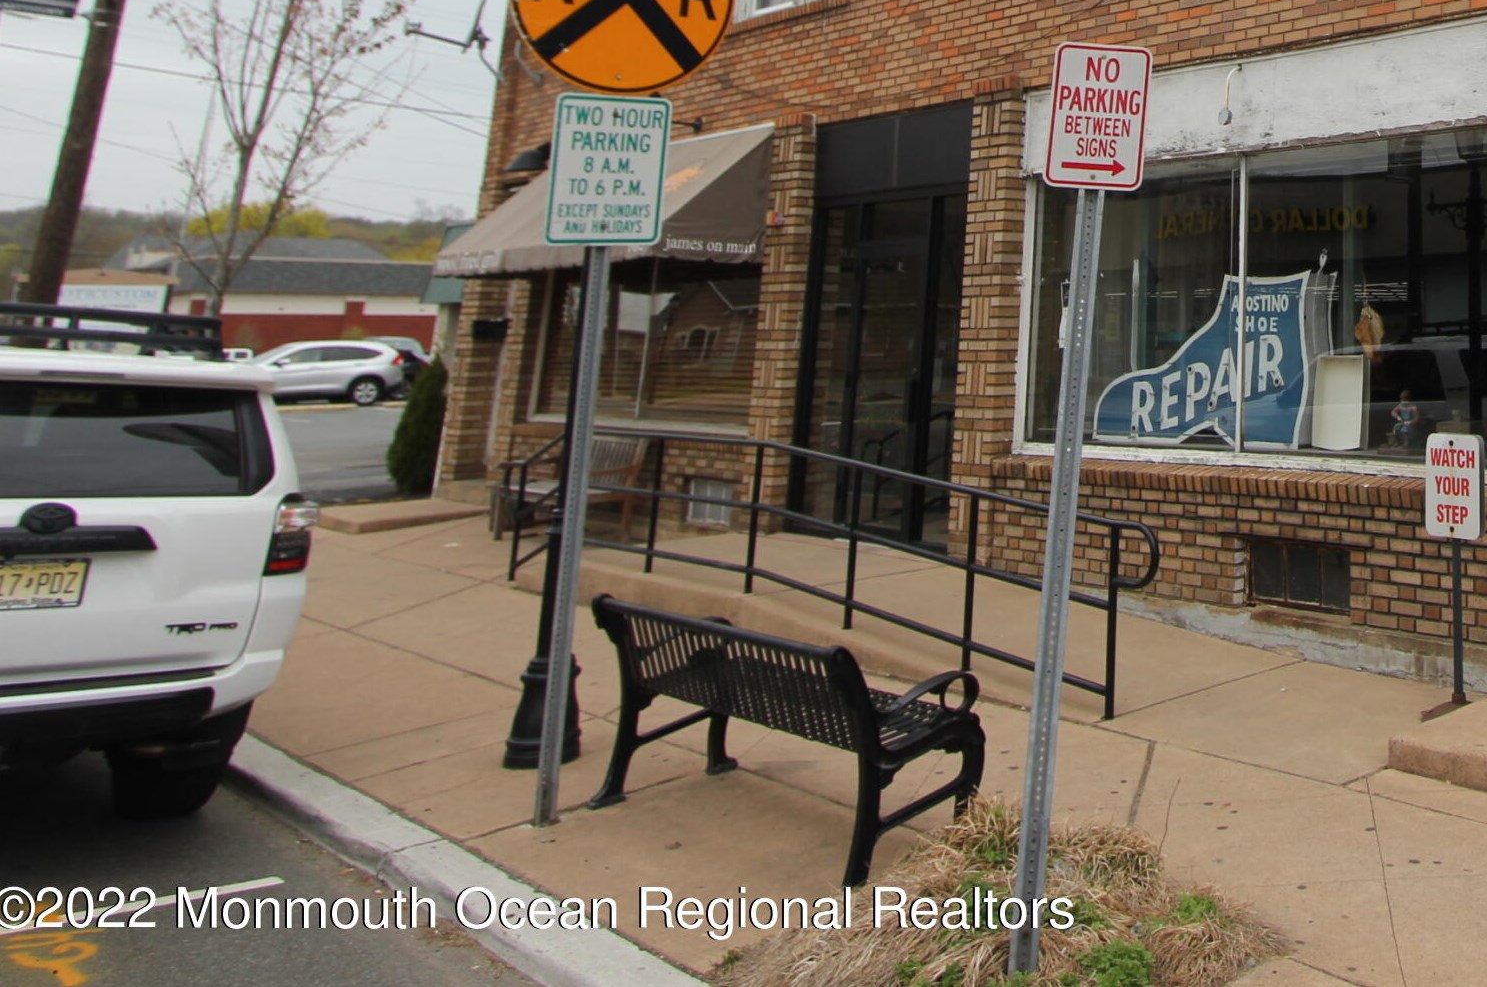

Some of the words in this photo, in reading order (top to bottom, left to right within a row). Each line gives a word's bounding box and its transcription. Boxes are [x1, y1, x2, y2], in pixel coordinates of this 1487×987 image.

[1085, 56, 1120, 83] NO
[1059, 85, 1141, 115] PARKING
[564, 105, 603, 126] TWO
[612, 107, 665, 129] HOUR
[1064, 115, 1131, 137] BETWEEN
[571, 131, 651, 153] PARKING
[1075, 137, 1117, 158] SIGNS
[583, 156, 594, 173] 8
[601, 158, 635, 174] A.M.
[568, 178, 588, 195] TO
[595, 180, 605, 196] 6
[612, 180, 646, 196] P.M.
[557, 203, 598, 218] EXCEPT
[603, 204, 651, 218] SUNDAYS
[663, 234, 703, 251] james
[707, 241, 722, 252] on
[726, 242, 757, 254] main
[1231, 293, 1289, 313] AOSTINO
[1131, 334, 1284, 433] REPAIR
[1430, 447, 1475, 469] WATCH
[1435, 475, 1470, 497] YOUR
[1436, 503, 1468, 525] STEP
[165, 622, 207, 635] TRD
[209, 622, 238, 630] PRO
